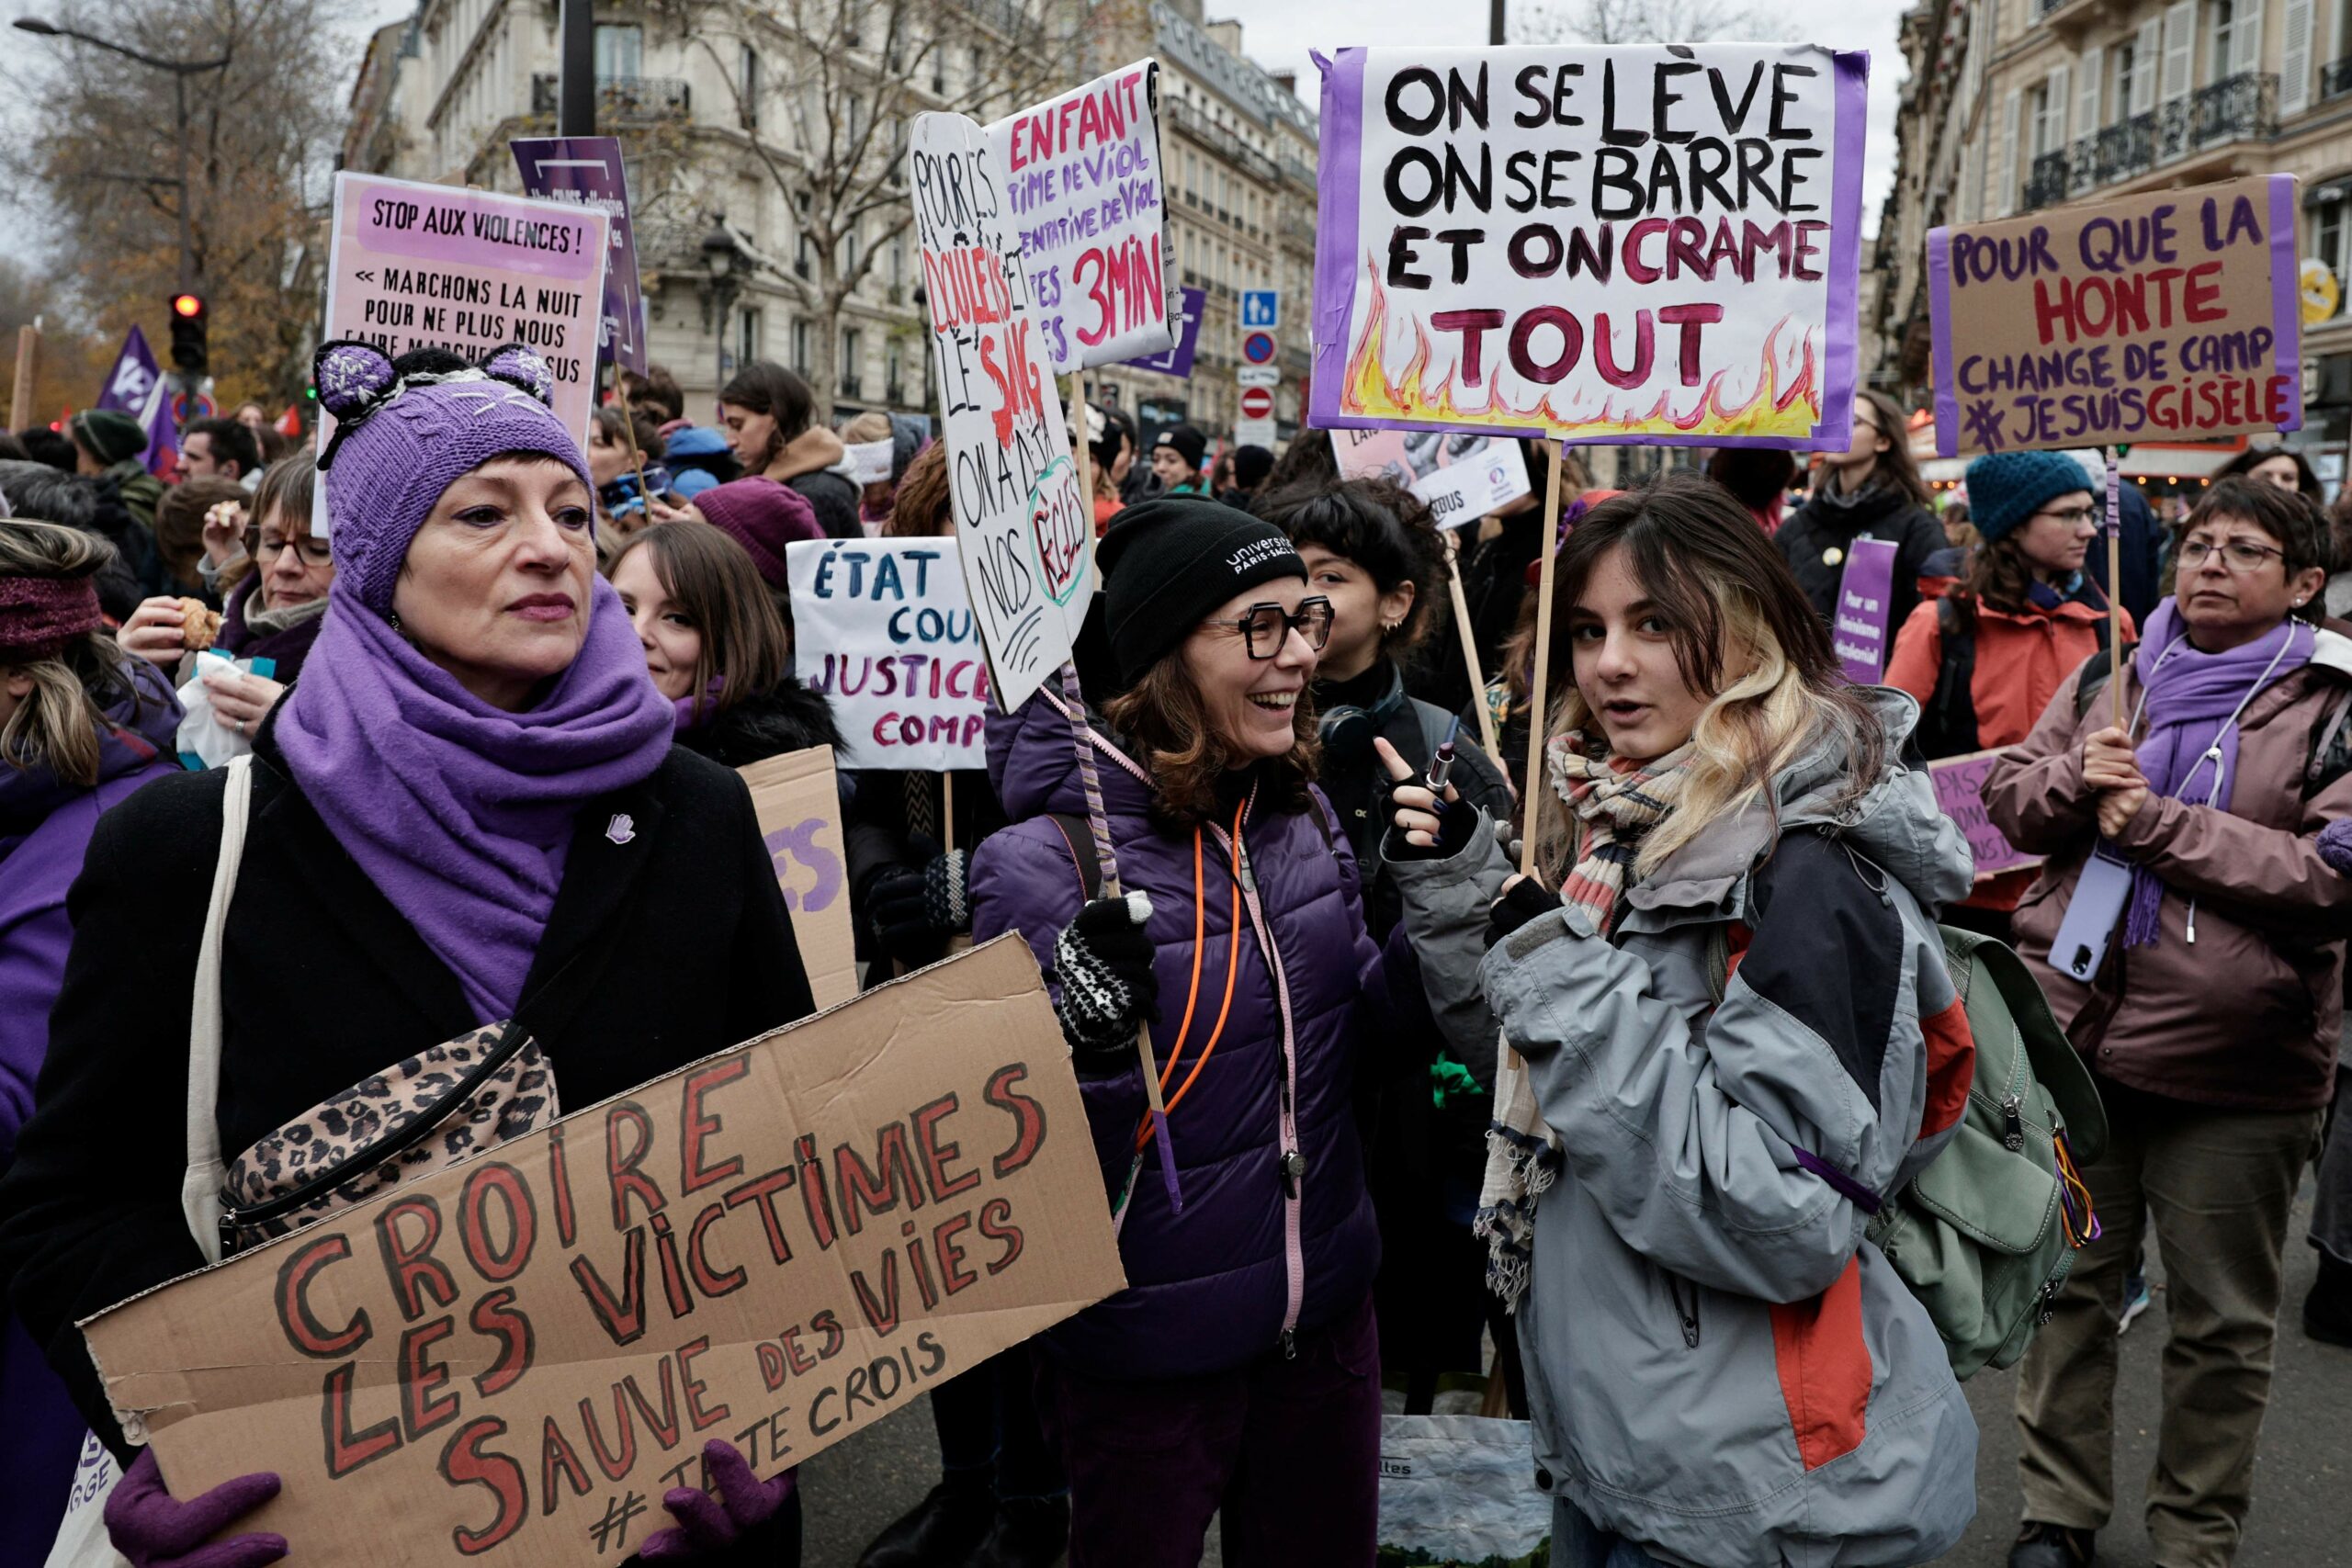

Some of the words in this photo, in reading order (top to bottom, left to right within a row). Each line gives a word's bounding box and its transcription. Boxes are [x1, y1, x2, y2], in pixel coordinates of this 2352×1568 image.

[1010, 71, 1142, 174] ENFANT
[1384, 60, 1490, 137] ON
[1514, 63, 1585, 130] SE
[1600, 44, 1820, 148] LÈVE
[913, 149, 974, 231] POUR
[1384, 141, 1492, 218] ON
[1504, 150, 1583, 214] SE
[1591, 137, 1826, 220] BARRE
[372, 198, 419, 231] STOP
[423, 206, 467, 237] AUX
[472, 212, 571, 254] VIOLENCES
[574, 227, 582, 255] !
[1386, 224, 1486, 290] ET
[1507, 221, 1614, 286] ON
[1621, 215, 1833, 286] CRAME
[1952, 225, 2060, 288] POUR
[2078, 204, 2177, 273] QUE
[2199, 195, 2265, 253] LA
[365, 299, 414, 327] POUR
[423, 306, 447, 333] NE
[456, 310, 504, 341] PLUS
[513, 318, 566, 349] NOUS
[383, 267, 492, 305] MARCHONS
[500, 283, 526, 310] LA
[536, 288, 582, 319] NUIT
[2032, 259, 2230, 346] HONTE
[939, 336, 981, 418] LE
[1430, 302, 1724, 390] TOUT
[1957, 344, 2116, 396] CHANGE
[2123, 339, 2168, 383] DE
[2178, 325, 2274, 374] CAMP
[957, 442, 998, 528] ON
[814, 540, 941, 601] ÉTAT
[978, 528, 1032, 642] NOS
[888, 605, 979, 647] COU
[809, 653, 989, 702] JUSTICE
[872, 711, 986, 749] COMP
[320, 1286, 536, 1482] LES
[734, 1405, 793, 1471] TE
[808, 1331, 947, 1438] CROIS
[437, 1335, 732, 1557] SAUVE
[755, 1308, 845, 1395] DES
